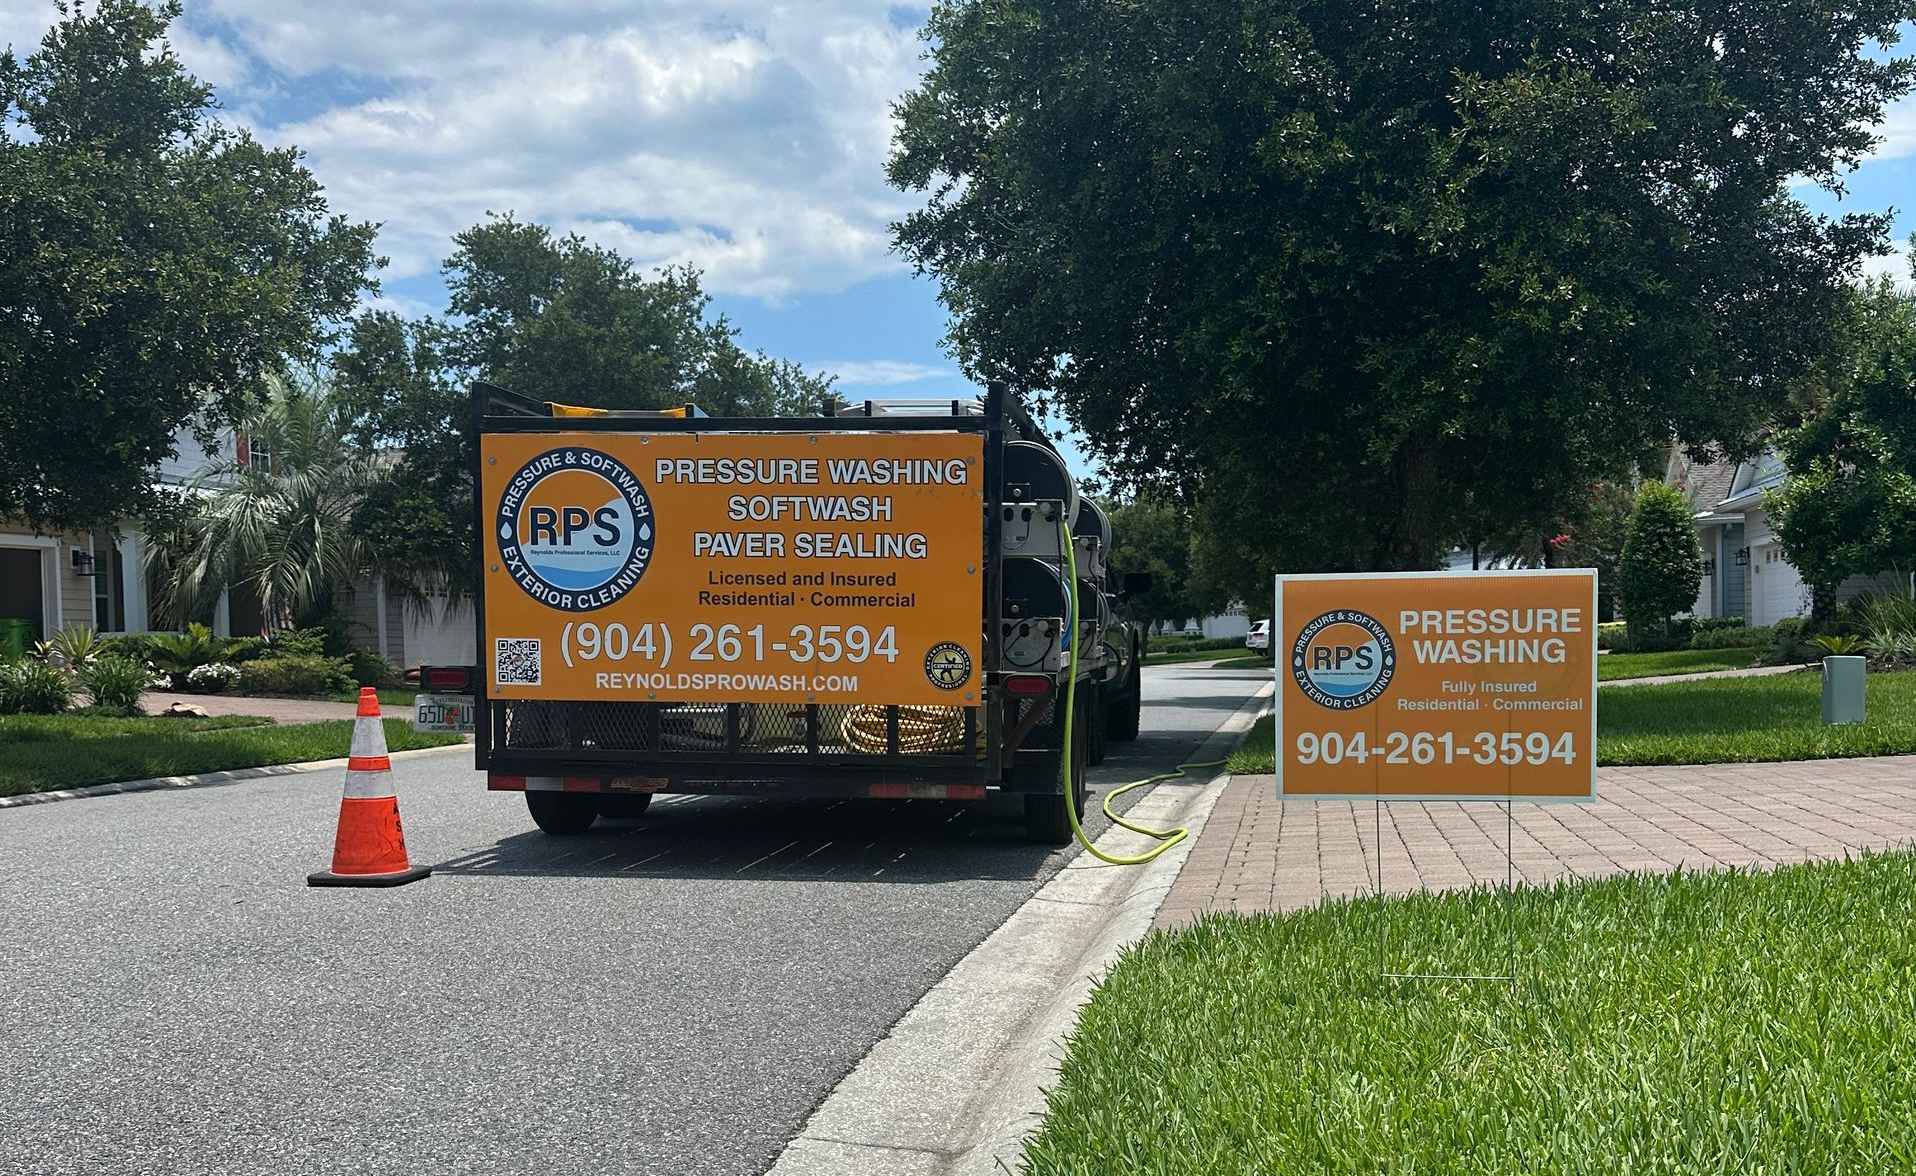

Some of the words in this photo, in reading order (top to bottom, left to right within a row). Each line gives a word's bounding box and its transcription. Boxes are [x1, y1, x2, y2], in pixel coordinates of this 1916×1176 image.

[501, 453, 562, 517] PRESSURE
[565, 451, 577, 464] &
[581, 452, 650, 518] SOFTWASH
[655, 458, 819, 485] PRESSURE
[827, 458, 968, 486] WASHING
[727, 495, 892, 522] SOFTWASH
[529, 506, 621, 547] RPS
[693, 531, 786, 558] PAVER
[793, 532, 928, 559] SEALING
[503, 545, 572, 608] EXTERIOR
[577, 546, 649, 608] CLEANING
[708, 571, 787, 586] Licensed
[792, 571, 825, 587] and
[830, 572, 897, 587] Insured
[698, 590, 795, 607] Residential
[810, 591, 915, 608] Commercial
[1295, 613, 1336, 654] PRESSURE
[1337, 612, 1345, 620] &
[1347, 612, 1392, 652] SOFTWASH
[1399, 608, 1582, 635] PRESSURE
[560, 621, 674, 669] (904)
[688, 623, 900, 663] 261-3594
[1313, 645, 1374, 671] RPS
[1412, 638, 1566, 664] WASHING
[595, 672, 858, 692] REYNOLDSPROWASH.COM
[1295, 670, 1341, 708] EXTERIOR
[1344, 669, 1392, 708] CLEANING
[1441, 680, 1476, 696] Fully
[1481, 680, 1537, 693] Insured
[1397, 698, 1480, 711] Residential
[1492, 697, 1583, 711] Commercial
[1295, 731, 1577, 765] 904-261-3594
